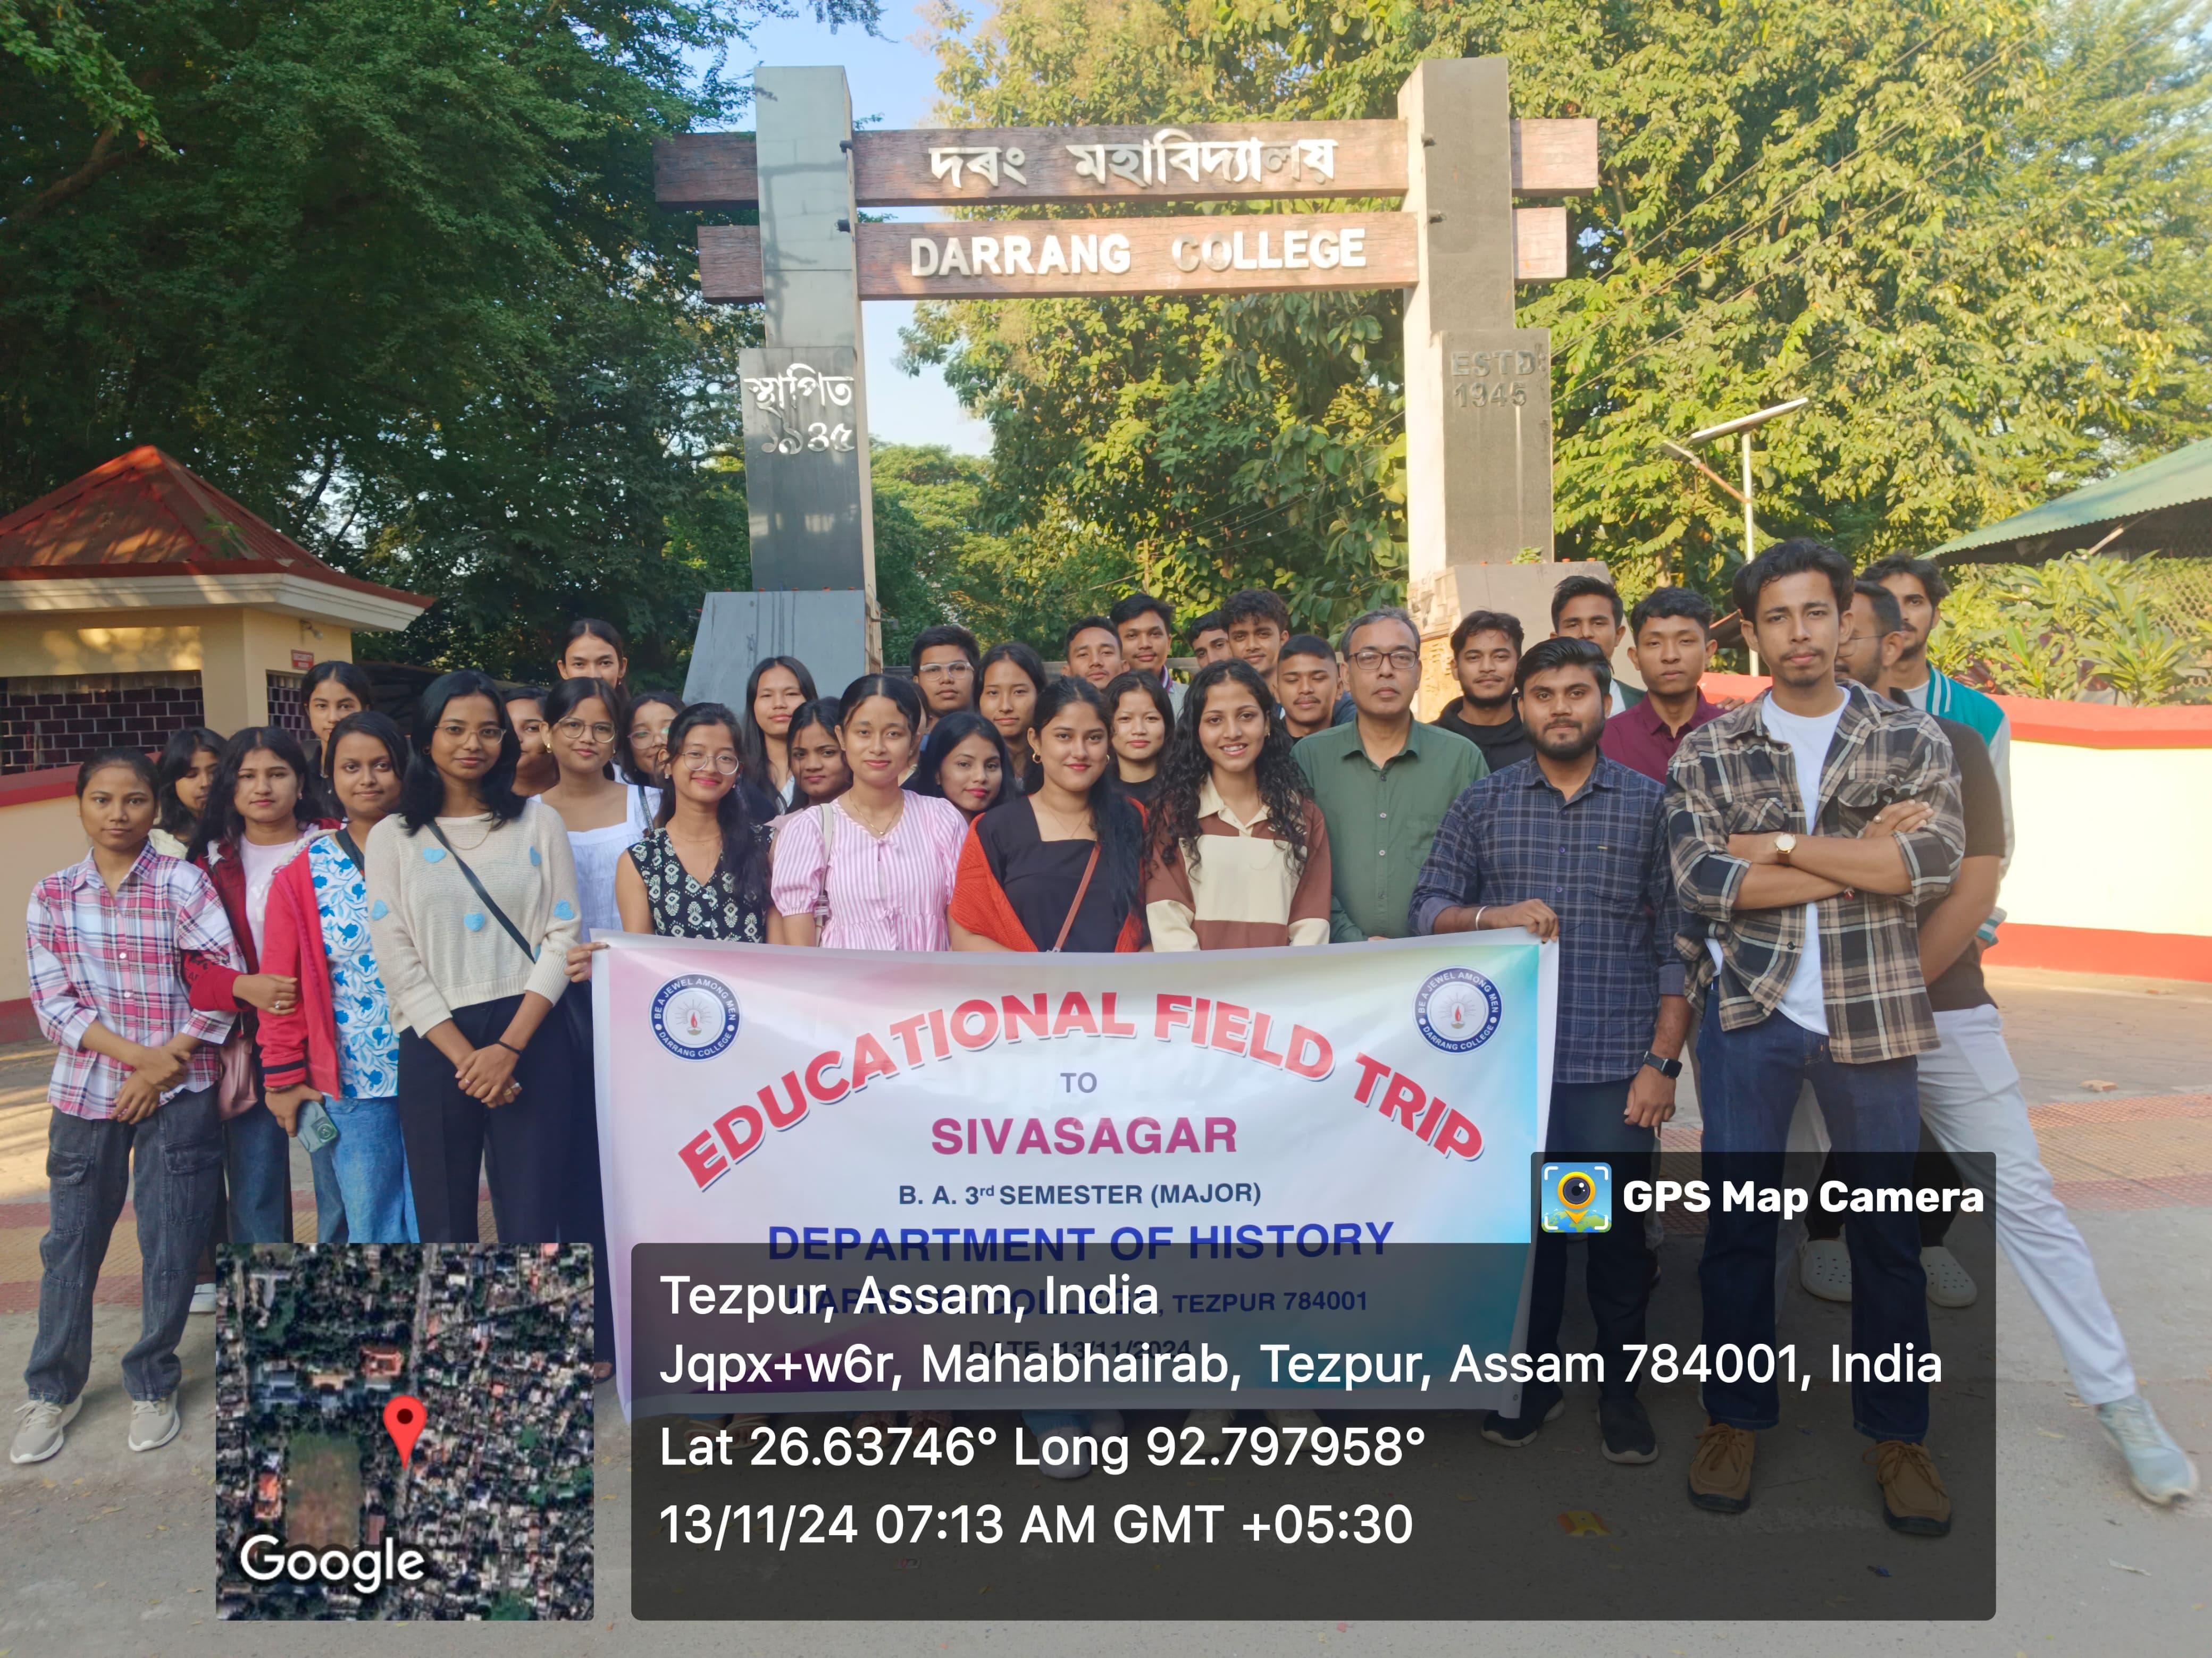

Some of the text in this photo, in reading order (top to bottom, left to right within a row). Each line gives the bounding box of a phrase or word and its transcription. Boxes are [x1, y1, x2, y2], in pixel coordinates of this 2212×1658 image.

[928, 128, 1339, 189] দৰং মহাবিদ্যালয়
[911, 228, 1367, 277] DARRANG COLLEGE
[743, 363, 855, 418] স্থাপিত
[1454, 382, 1527, 408] 1945
[654, 1006, 663, 1020] BE
[663, 979, 694, 998] JEWEL
[696, 978, 729, 999] AMONG
[726, 1000, 736, 1021] MEN
[1418, 1000, 1426, 1014] BE
[1427, 972, 1456, 992] JEWEL
[1458, 972, 1492, 993] AMONG
[1489, 992, 1499, 1013] MEN
[659, 1031, 732, 1057] DARRANG COLLEGE
[1422, 1024, 1494, 1050] DARRANG COLLEGE
[677, 991, 1485, 1192] EDUCATIONAL FIELD TRIP
[1060, 1071, 1097, 1093] TO
[931, 1116, 1237, 1155] SIVASAGAR
[899, 1182, 1261, 1208] B. A. 3rd SEMESTER (MAJOR)
[768, 1222, 1394, 1262] DEPARTMENT OF HISTORY
[1172, 1292, 1275, 1314] TEZPUR
[1284, 1291, 1367, 1311] 784001
